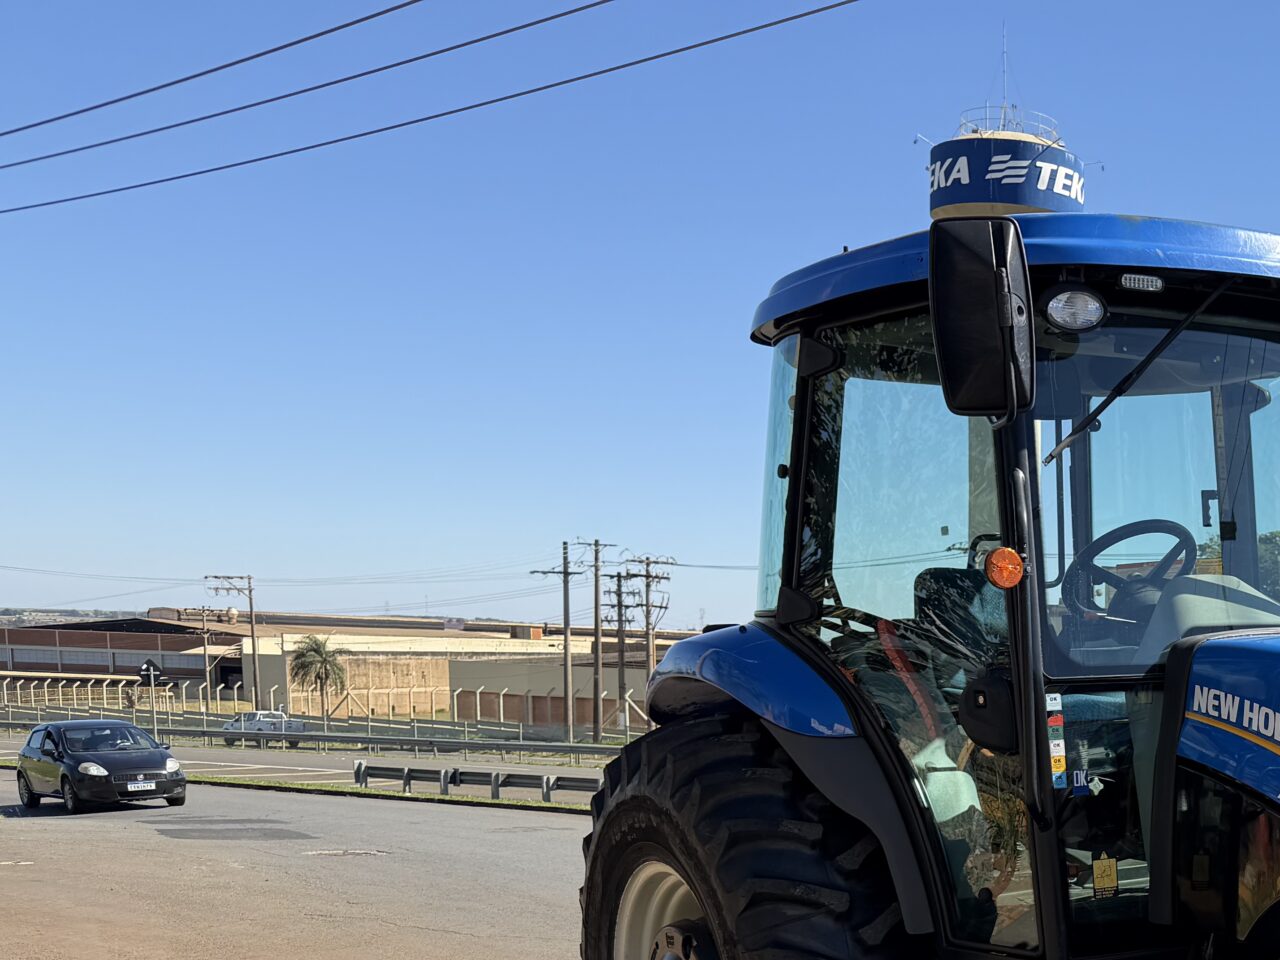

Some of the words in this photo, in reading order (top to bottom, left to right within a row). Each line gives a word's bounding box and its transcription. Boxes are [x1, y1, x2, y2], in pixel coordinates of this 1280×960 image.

[1035, 161, 1085, 205] TEK
[1193, 685, 1240, 723] NEW
[1073, 770, 1088, 787] OK
